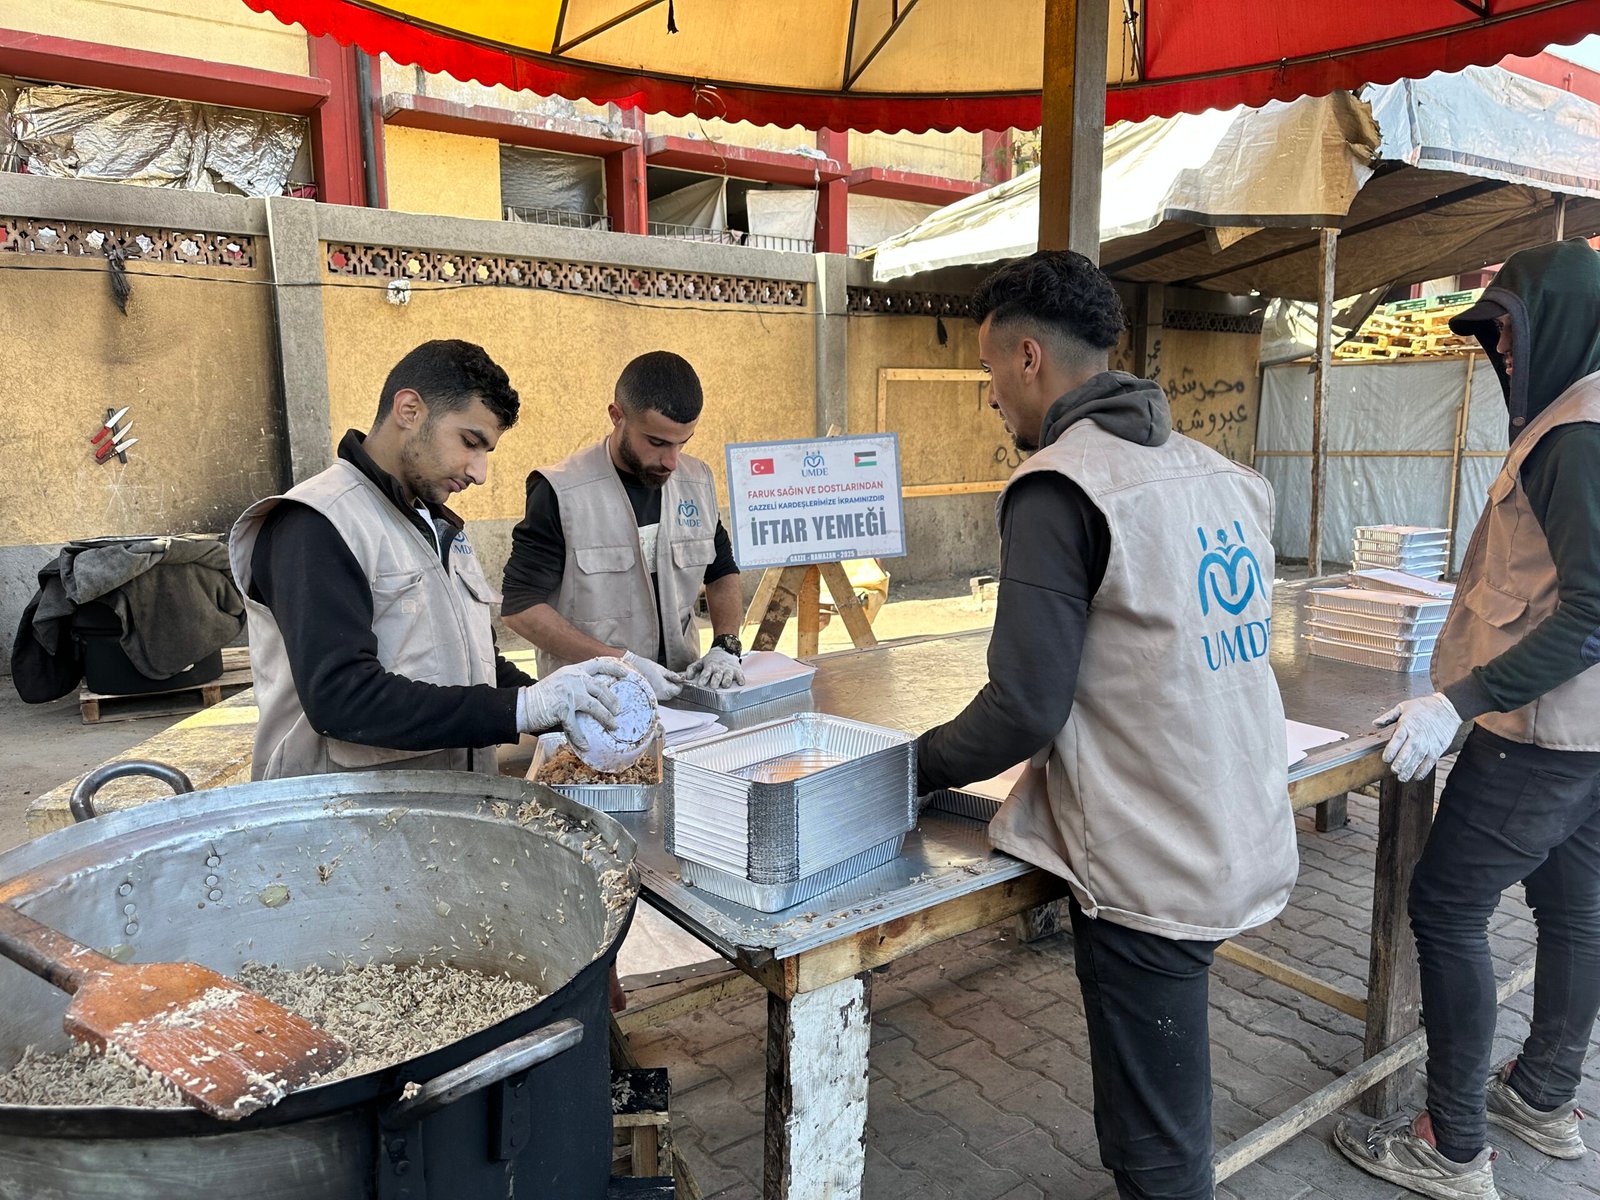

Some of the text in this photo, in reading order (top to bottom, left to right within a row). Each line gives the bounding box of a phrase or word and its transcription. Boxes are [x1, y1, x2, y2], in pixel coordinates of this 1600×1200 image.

[801, 467, 829, 478] UMDE
[748, 481, 884, 499] FARUK SAĞIN VE DOSTLARINDAN
[748, 494, 885, 512] GAZZELİ KARDEŞLERİMİZE İKRAMINIZDIR
[677, 519, 702, 528] UMDE
[750, 506, 887, 546] İFTAR YEMEĞİ
